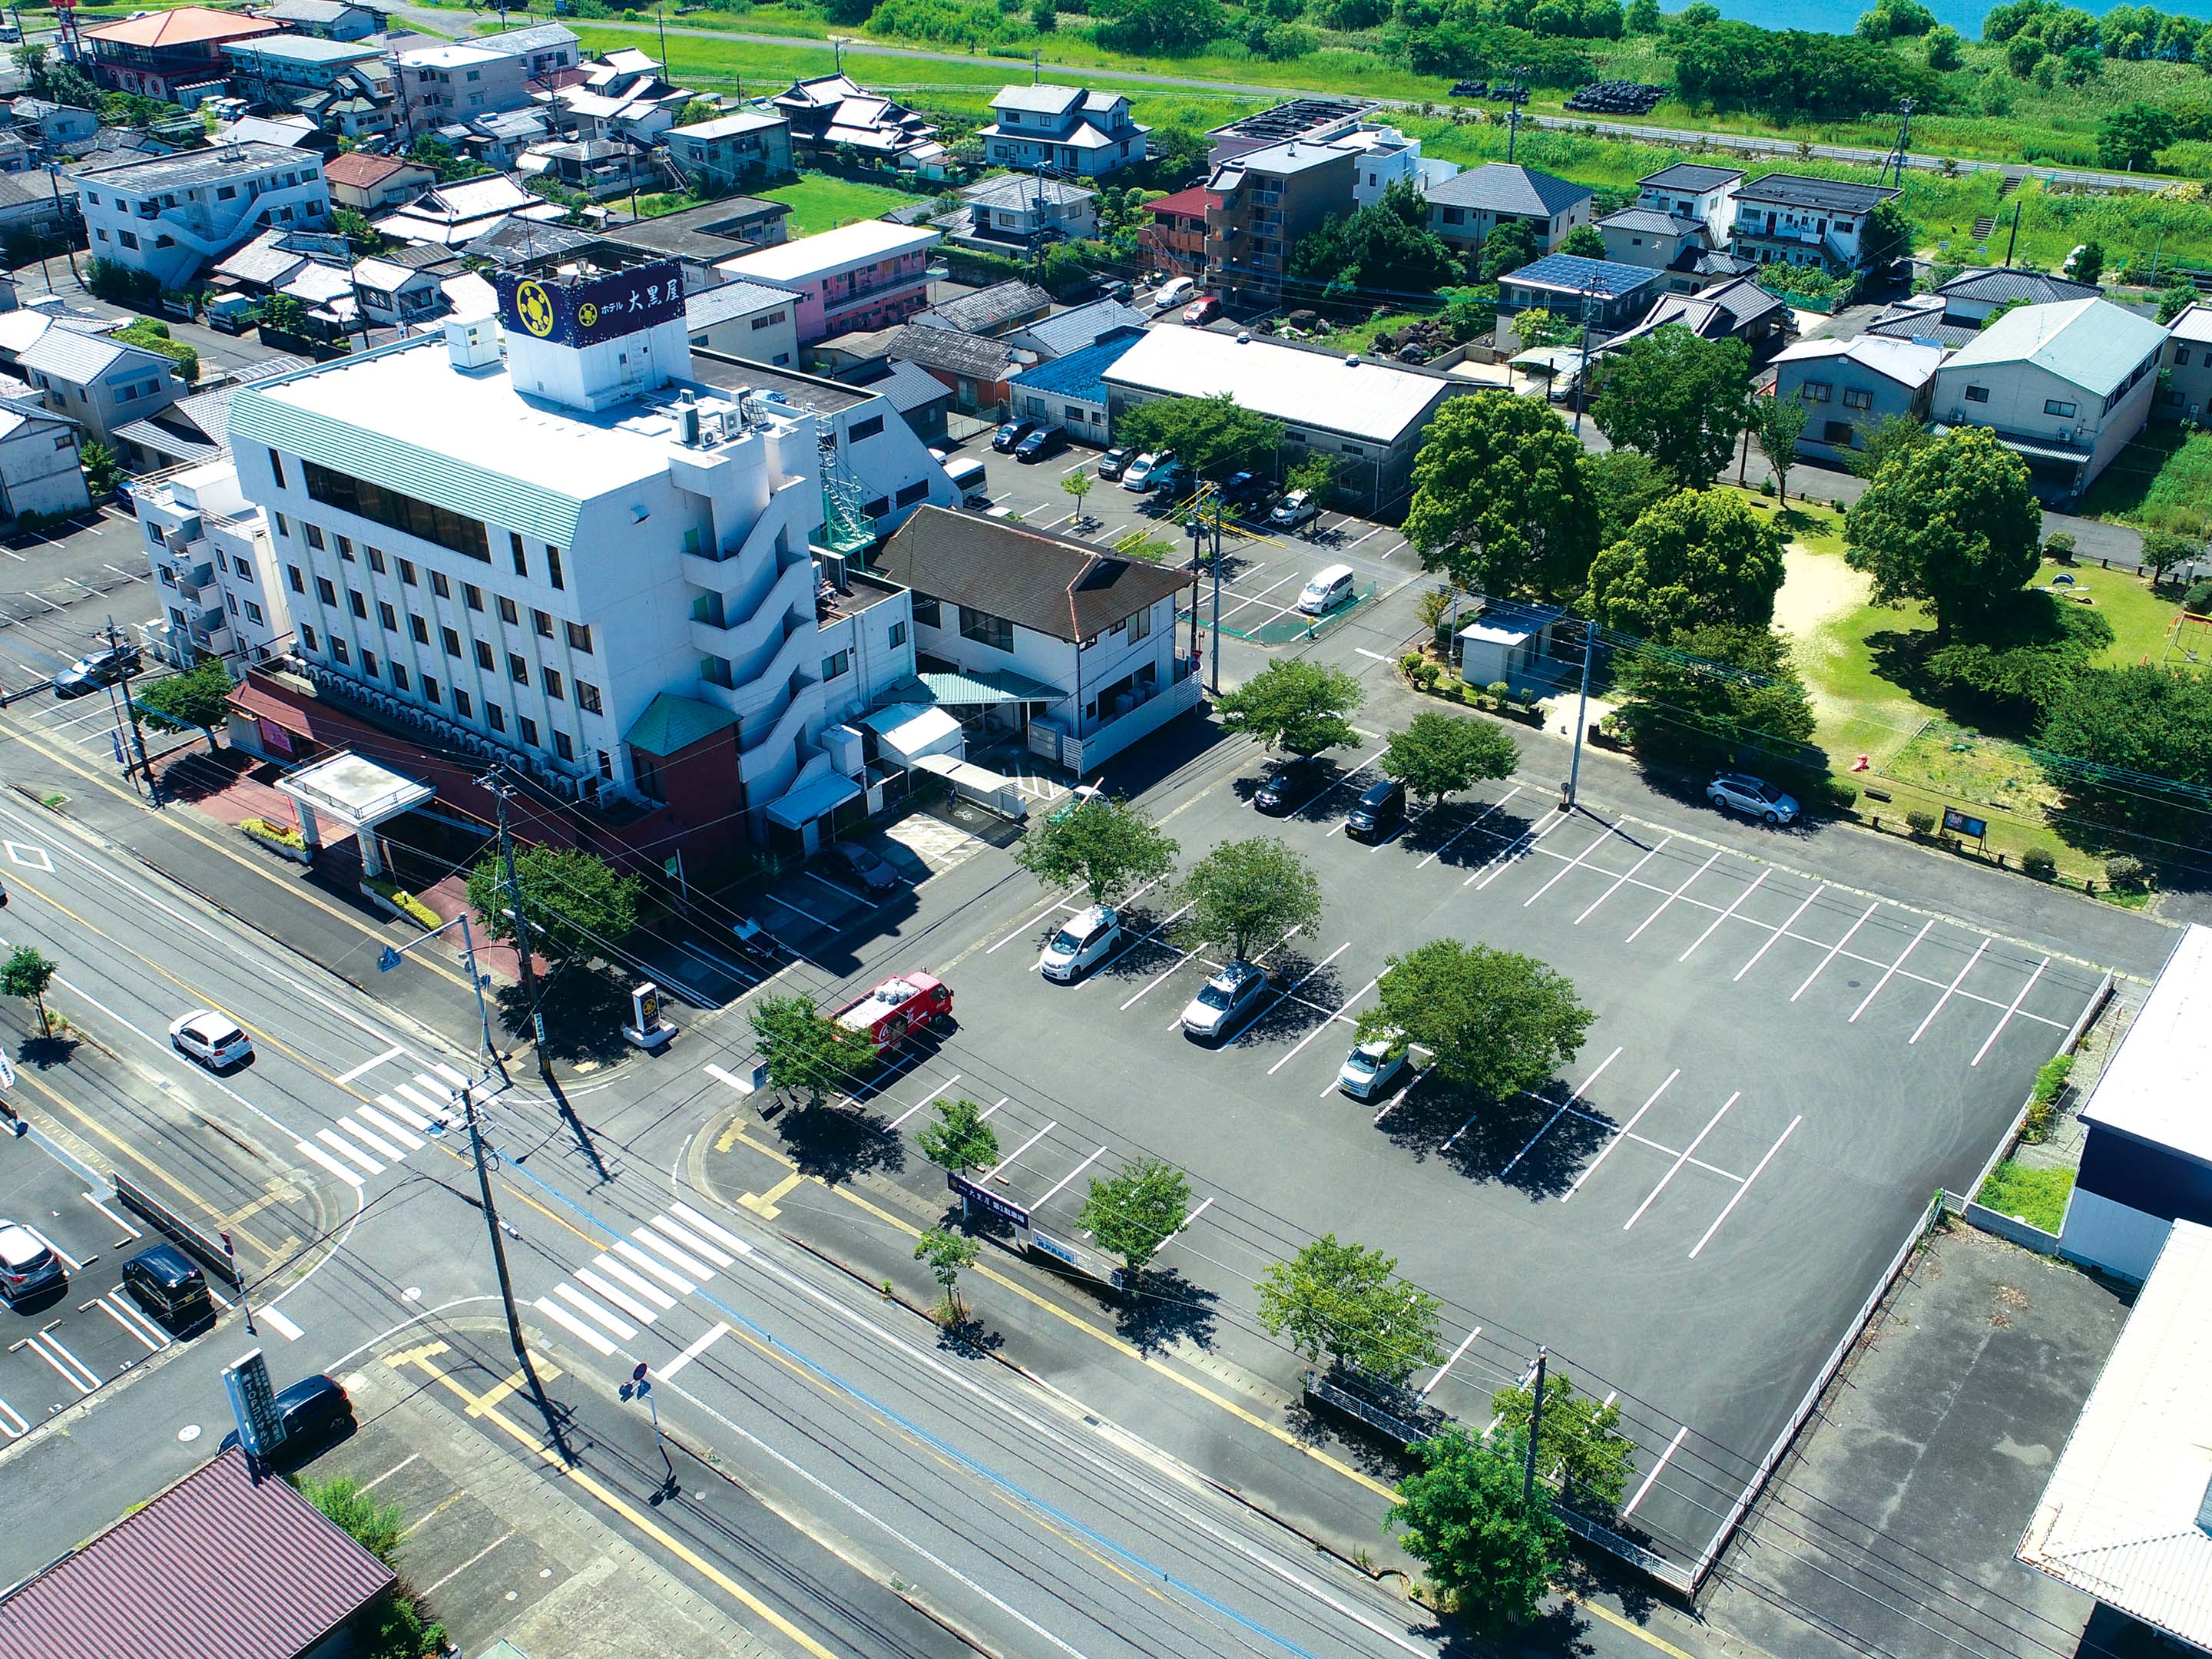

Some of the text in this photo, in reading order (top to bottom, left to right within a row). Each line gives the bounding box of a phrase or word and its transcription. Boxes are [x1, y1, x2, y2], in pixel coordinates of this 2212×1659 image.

[601, 279, 680, 316] ホテル 大黒屋
